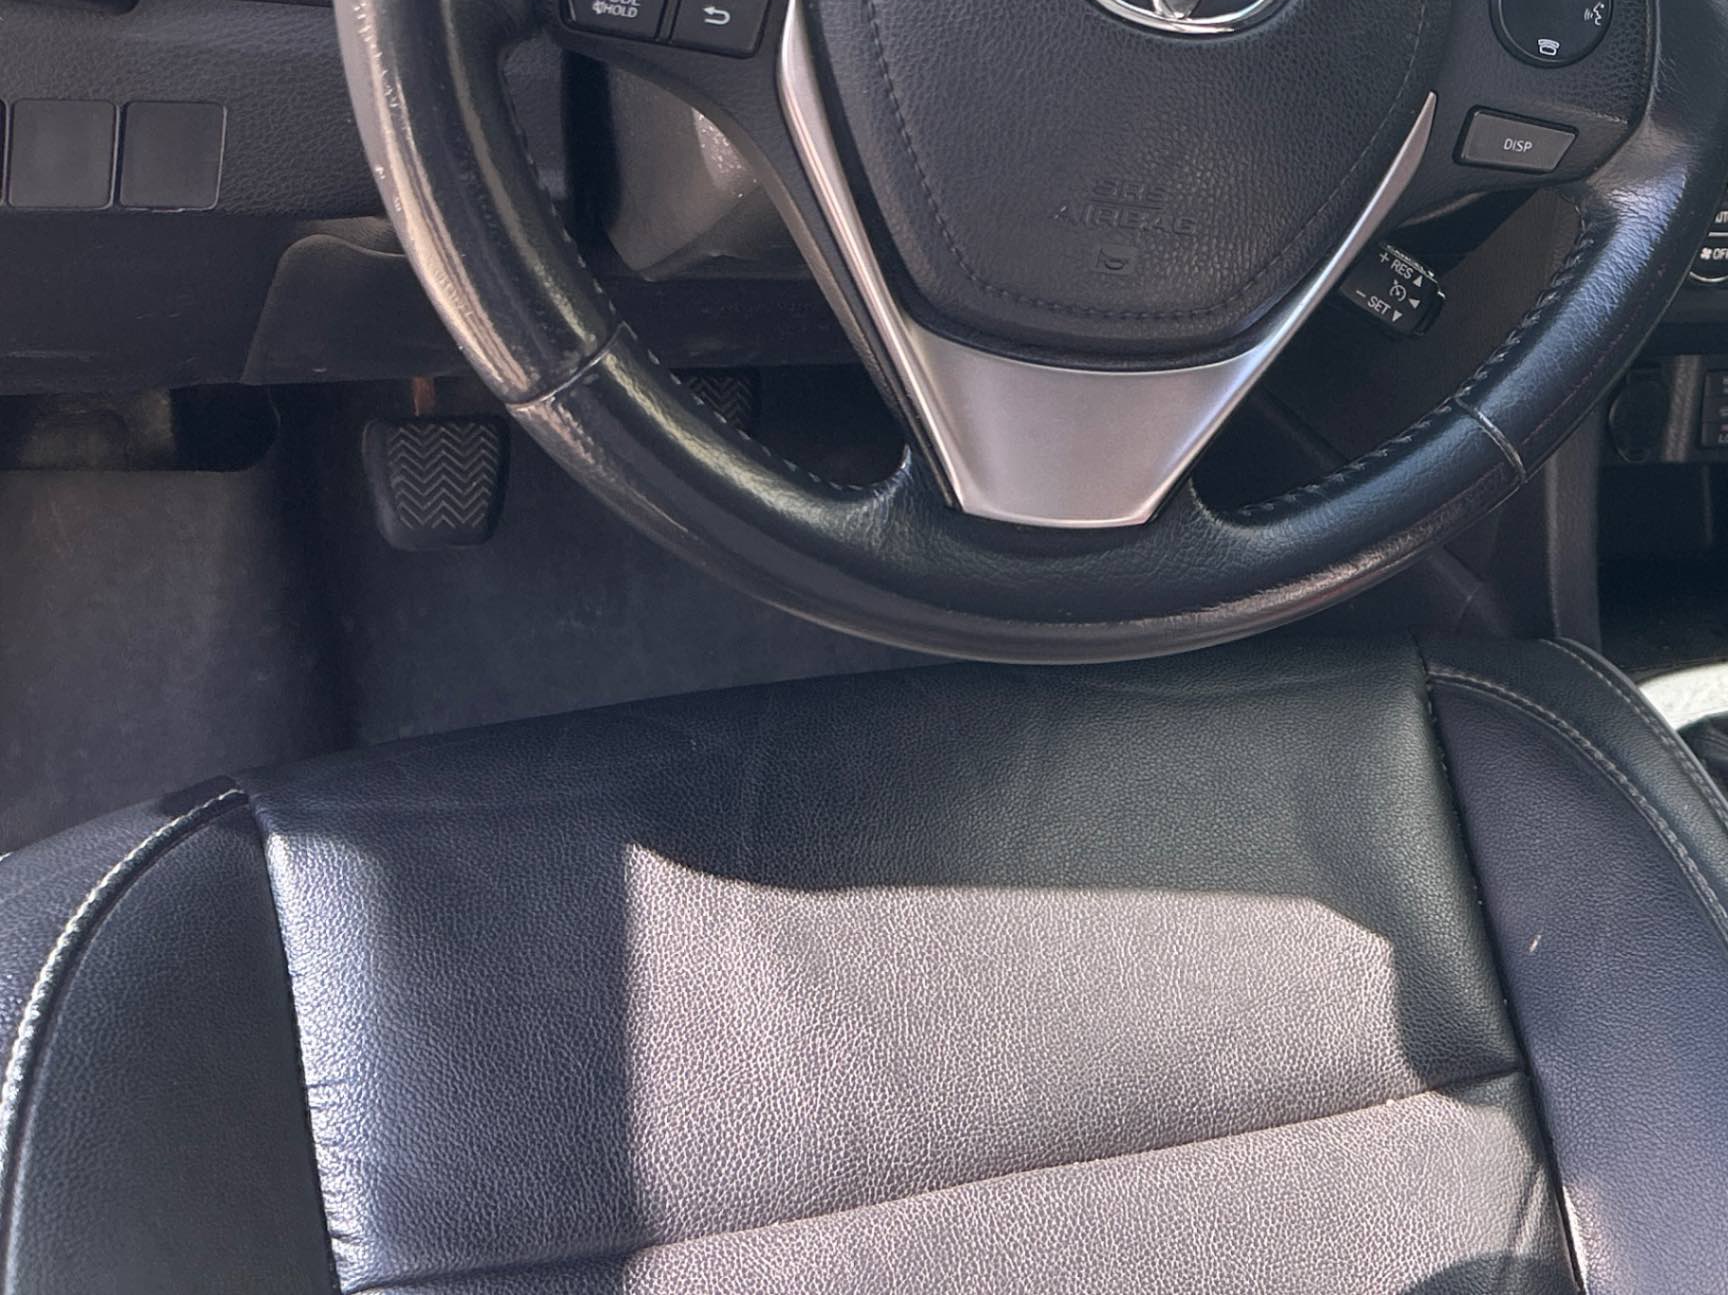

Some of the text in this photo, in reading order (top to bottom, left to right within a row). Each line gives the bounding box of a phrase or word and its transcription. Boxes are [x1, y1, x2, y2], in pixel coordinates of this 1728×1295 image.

[603, 3, 638, 18] HOLD
[1503, 138, 1533, 153] DISP
[1390, 259, 1413, 280] RES
[1367, 295, 1391, 315] SET
